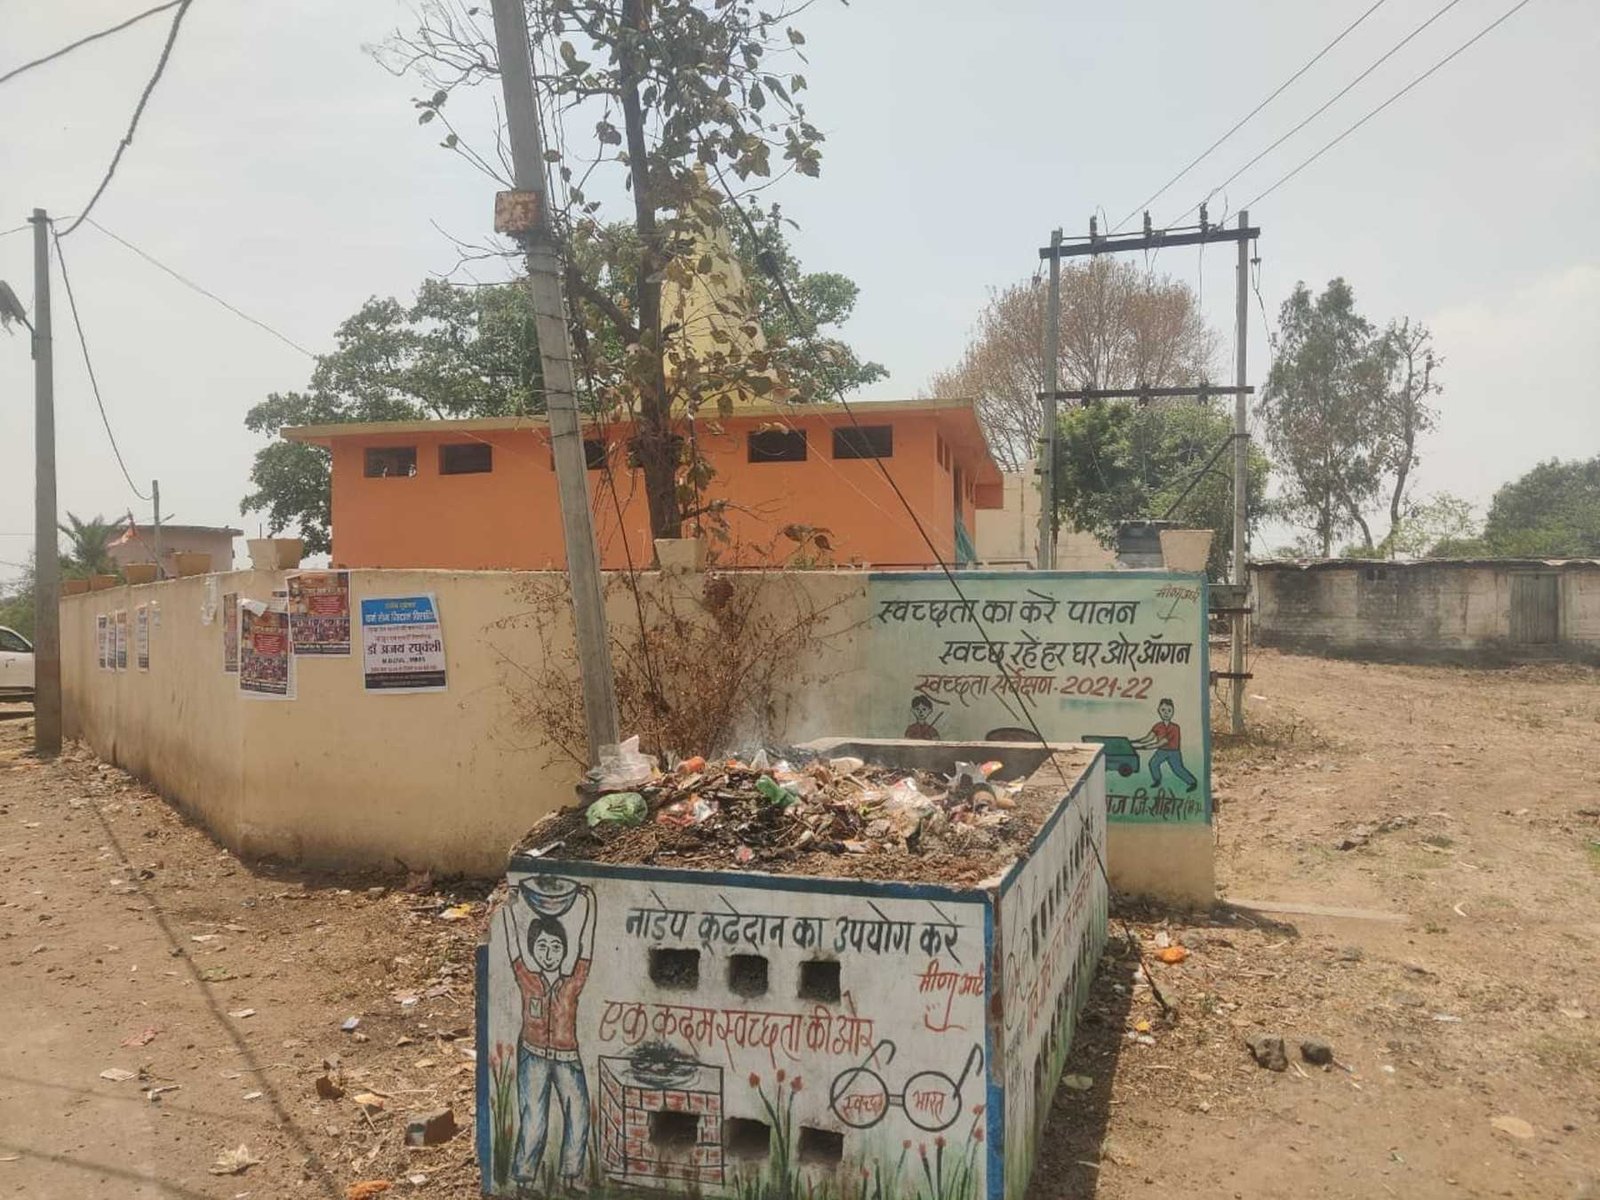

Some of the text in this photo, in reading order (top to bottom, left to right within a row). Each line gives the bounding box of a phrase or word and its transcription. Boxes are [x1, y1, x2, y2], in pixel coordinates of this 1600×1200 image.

[878, 588, 1141, 628] स्वच्छता का करें पालन
[939, 641, 1010, 665] स्वच्छ
[1041, 642, 1071, 671] हर
[1072, 642, 1102, 668] घर
[914, 674, 991, 707] स्वच्छता
[792, 917, 829, 949] का
[834, 900, 916, 955] उपयोग
[600, 1000, 648, 1046] एक
[651, 1003, 717, 1056] कदम
[715, 1009, 802, 1072] स्वच्छता
[805, 1005, 832, 1050] की
[912, 1090, 946, 1125] भारत
